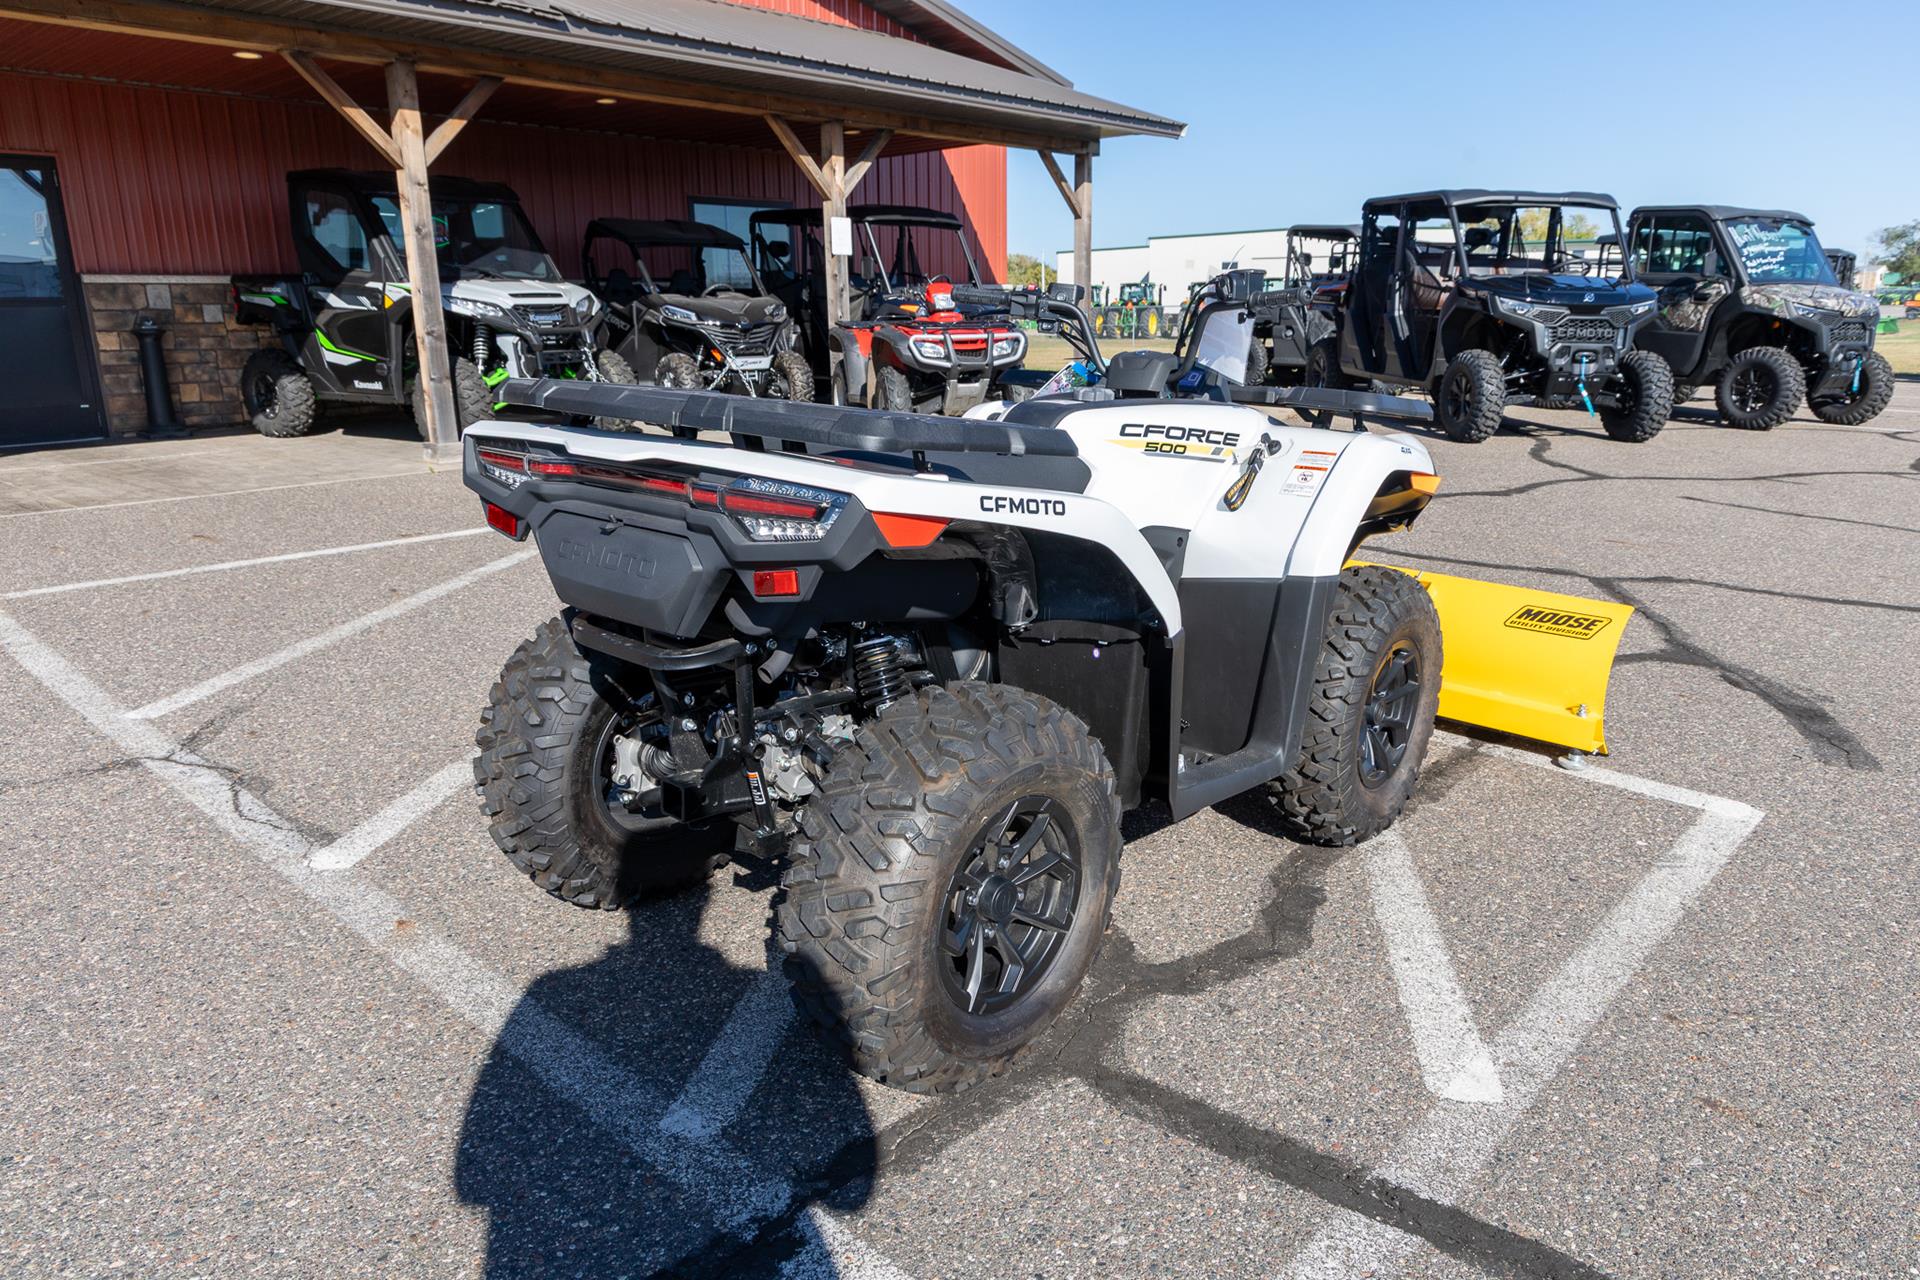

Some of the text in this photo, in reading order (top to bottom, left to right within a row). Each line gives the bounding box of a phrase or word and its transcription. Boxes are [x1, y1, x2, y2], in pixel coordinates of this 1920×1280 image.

[1556, 327, 1614, 338] CFMOTO
[1119, 423, 1241, 447] CFORCE
[1144, 441, 1188, 455] 500
[979, 495, 1066, 516] CFMOTO
[558, 540, 658, 580] CFMOTO
[1509, 619, 1591, 637] UTILITY DIVISION
[1516, 607, 1604, 631] MOOSE
